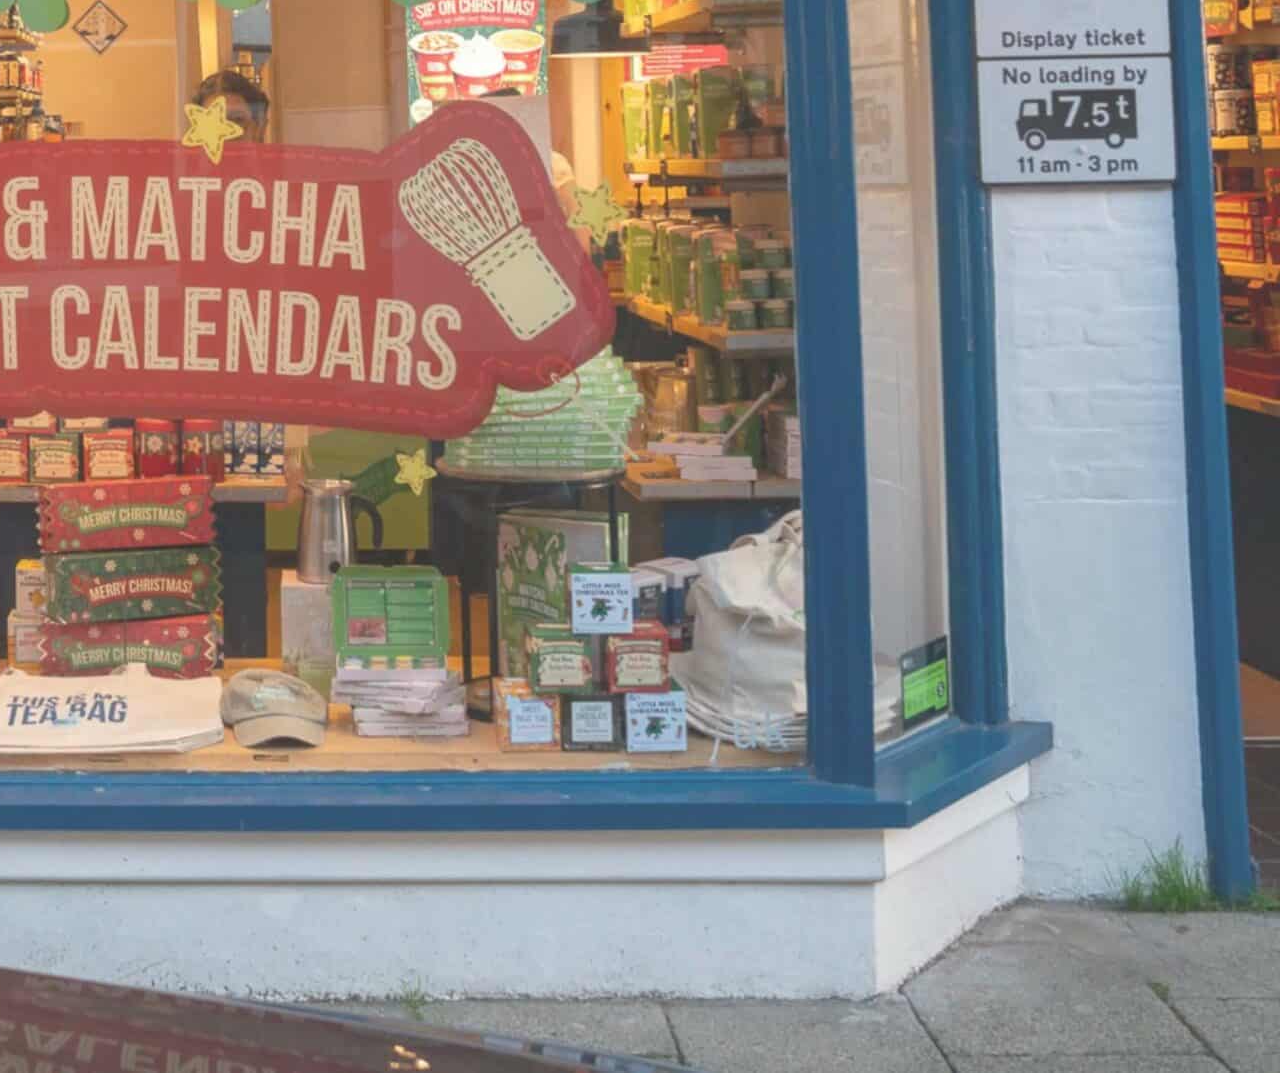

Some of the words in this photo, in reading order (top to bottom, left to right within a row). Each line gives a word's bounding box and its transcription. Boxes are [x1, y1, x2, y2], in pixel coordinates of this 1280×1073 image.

[414, 2, 435, 19] SIP
[437, 0, 457, 15] ON
[1001, 29, 1078, 51] Display
[1085, 29, 1146, 47] ticket
[1002, 68, 1032, 85] No
[1039, 66, 1116, 87] loading
[1123, 67, 1148, 85] by
[1017, 157, 1037, 173] 11
[1040, 160, 1071, 173] am
[1088, 156, 1102, 173] 3
[1107, 158, 1139, 175] pm
[3, 177, 48, 261] &
[71, 175, 366, 271] MATCHA
[49, 284, 462, 390] CALENDARS
[78, 511, 117, 529] MERRY
[119, 506, 187, 525] CHRISTMAS!
[89, 583, 127, 601] MERRY
[129, 577, 193, 595] CHRISTMAS!
[71, 648, 111, 666] MERRY
[7, 703, 58, 726] TEA
